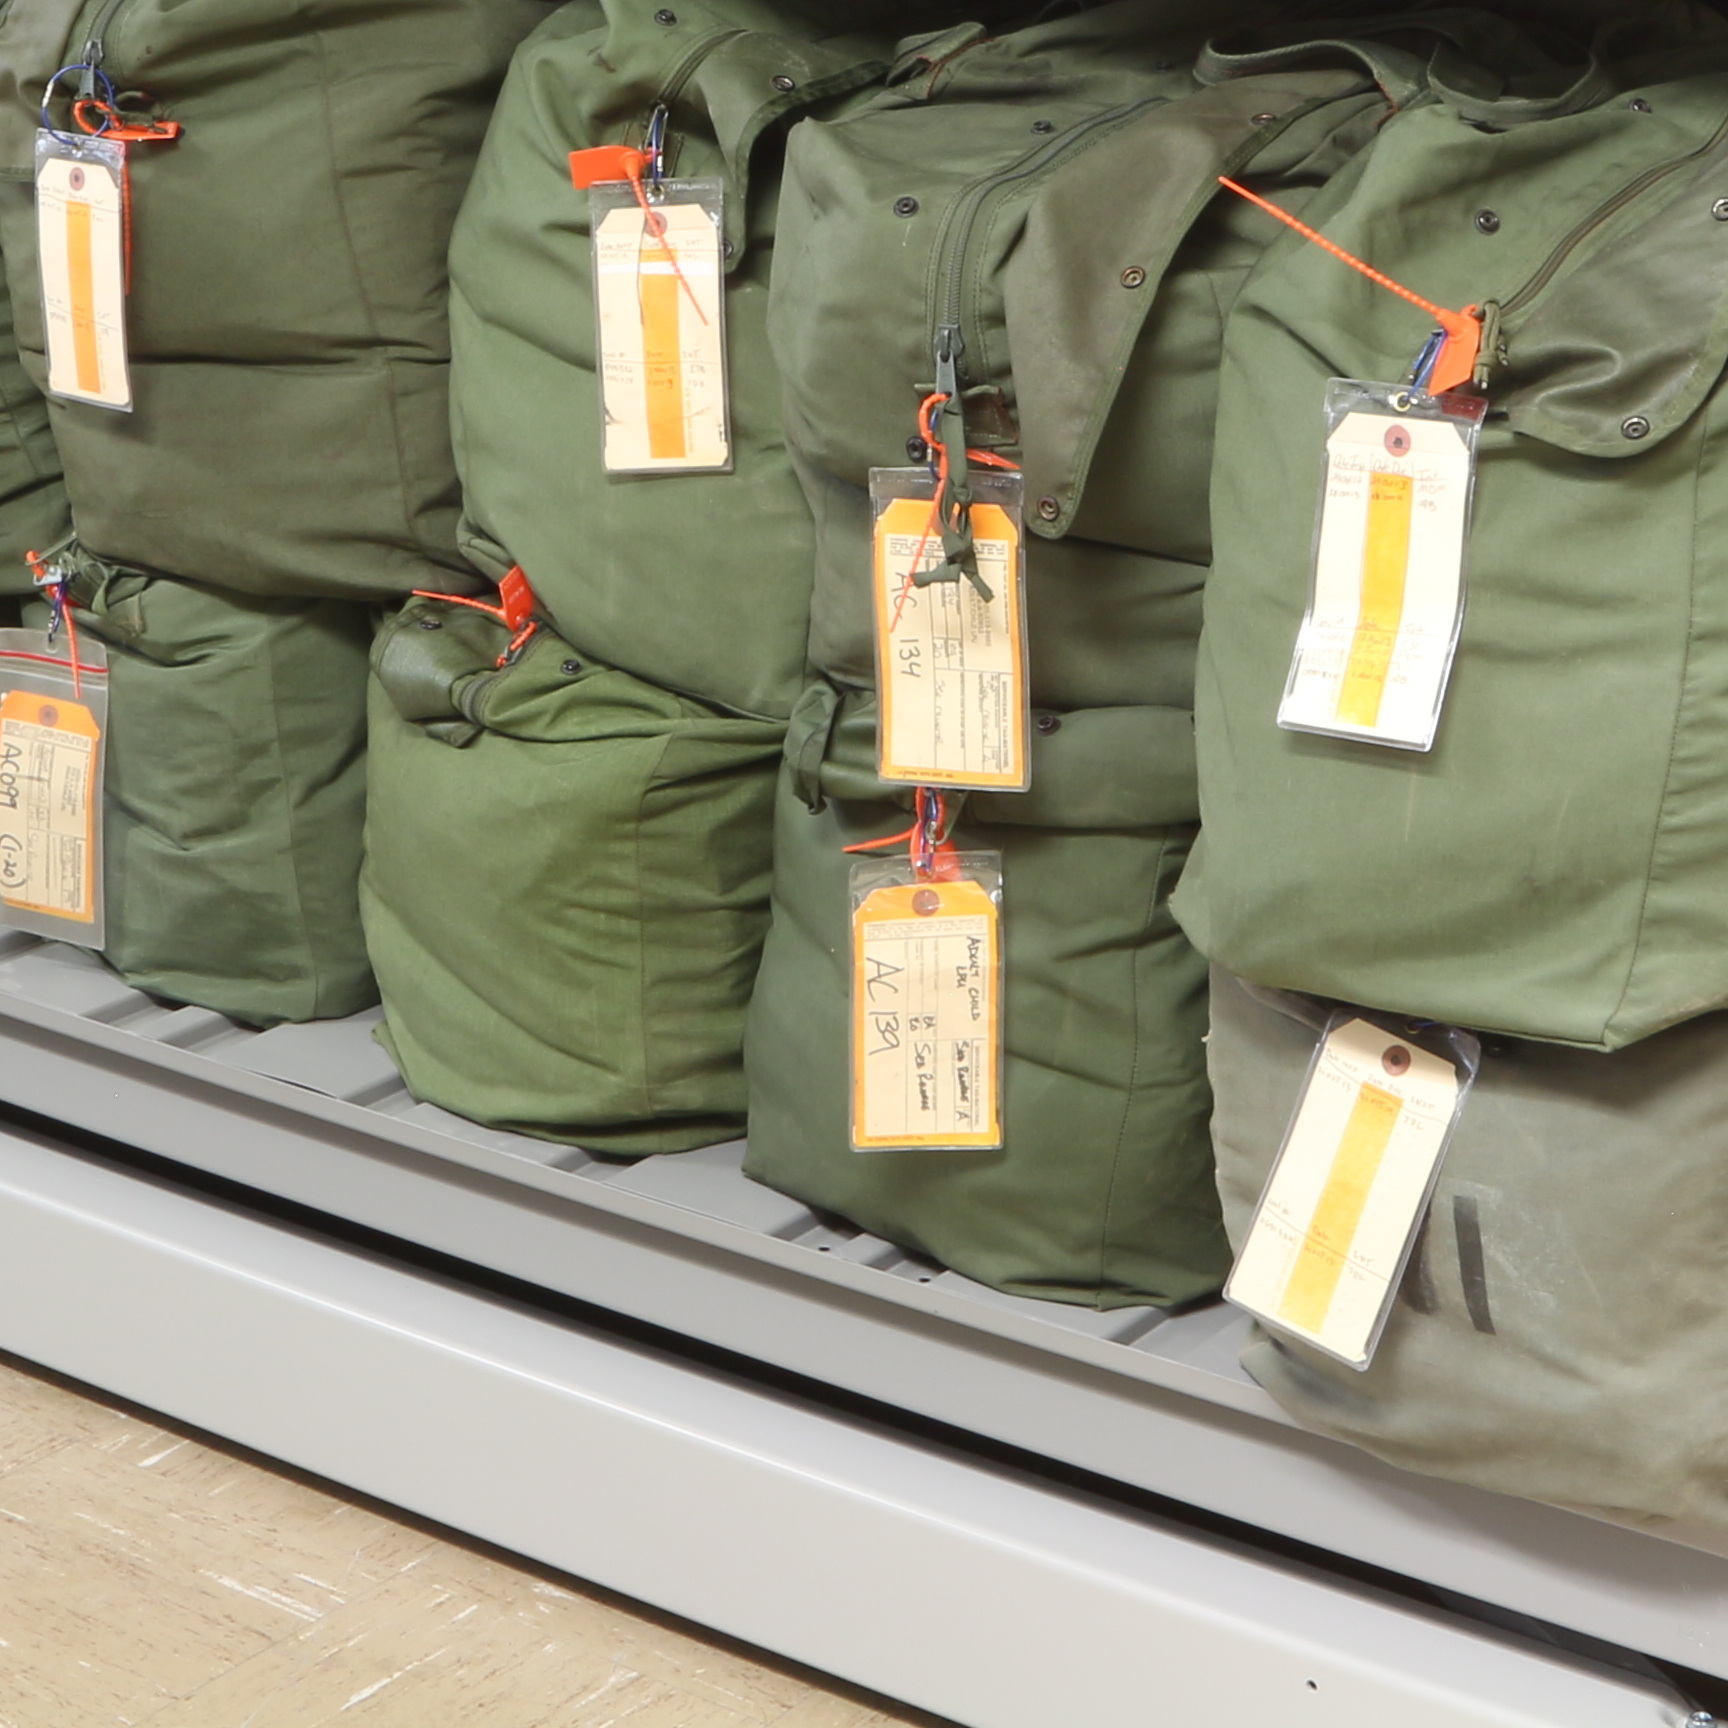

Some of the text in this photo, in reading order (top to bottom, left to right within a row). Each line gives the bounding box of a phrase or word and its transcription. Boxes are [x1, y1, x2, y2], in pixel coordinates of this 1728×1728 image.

[899, 638, 922, 679] 134
[865, 957, 906, 1056] AC 139
